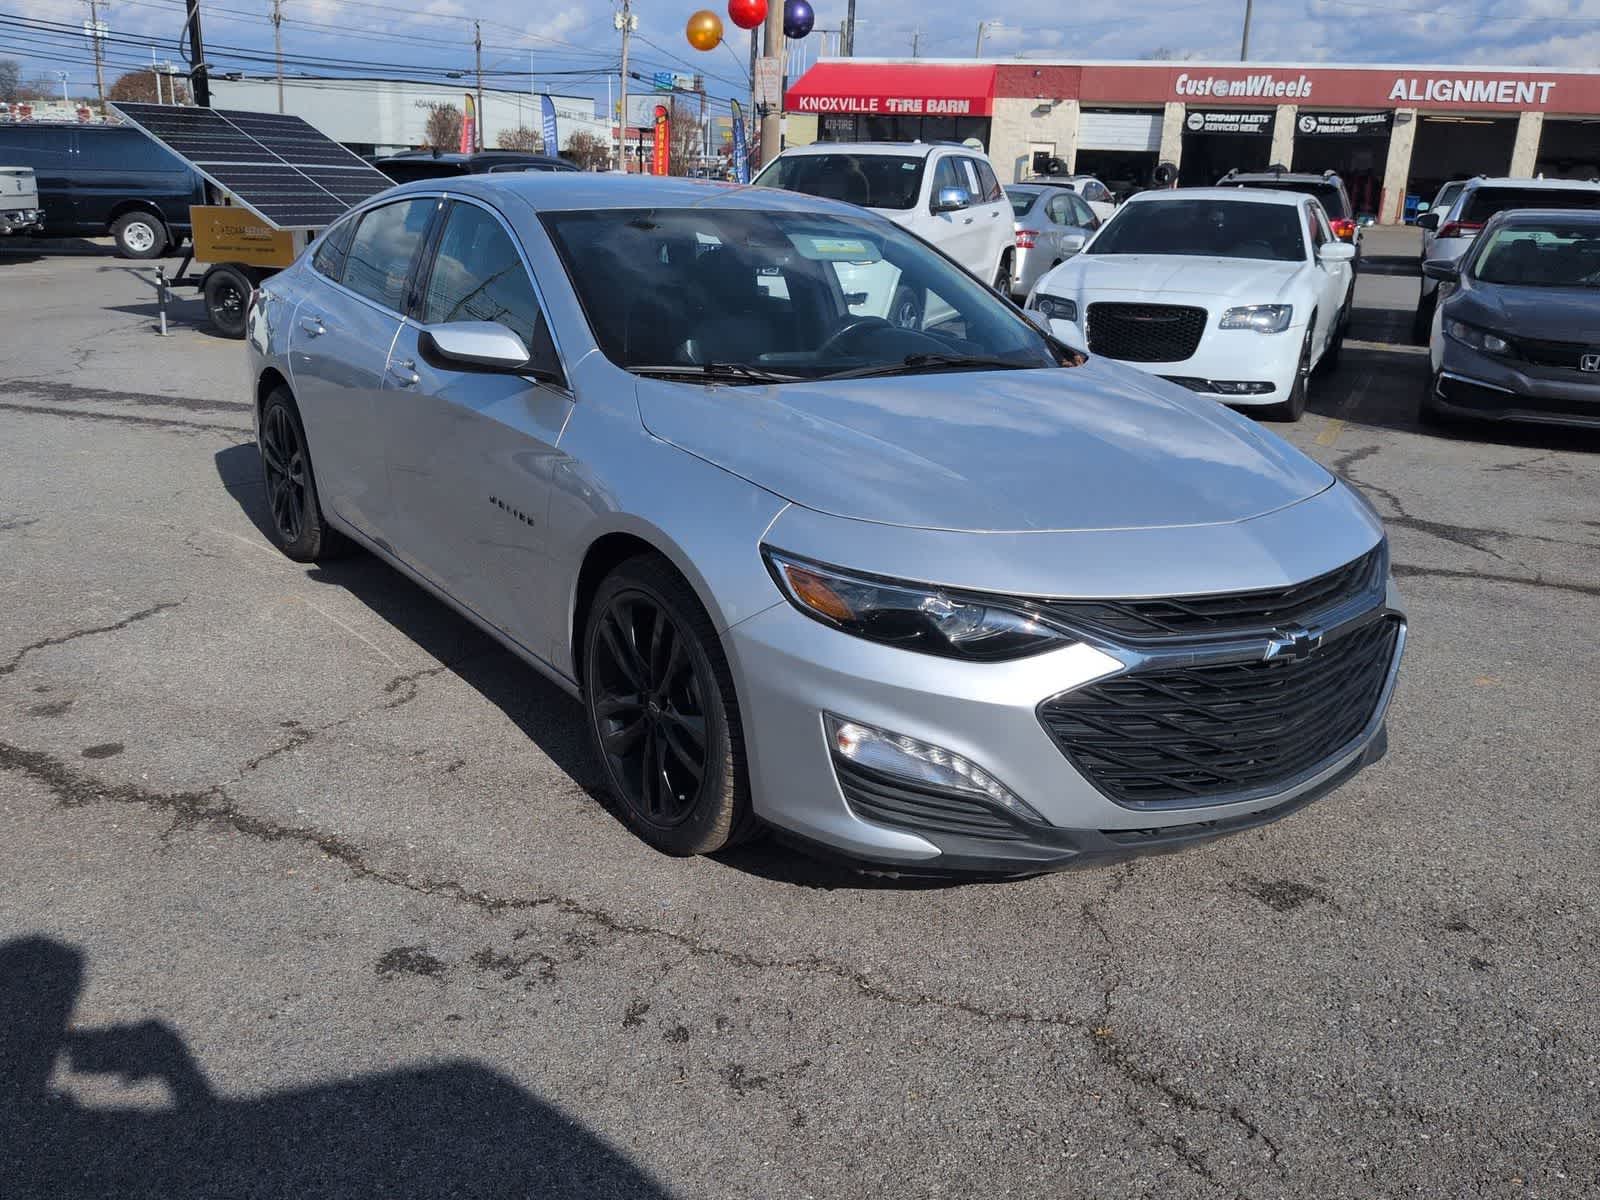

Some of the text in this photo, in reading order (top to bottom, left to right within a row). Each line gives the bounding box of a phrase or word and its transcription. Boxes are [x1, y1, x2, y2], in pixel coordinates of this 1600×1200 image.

[1388, 78, 1556, 105] ALIGNMENT
[799, 96, 879, 112] KNOXVILLE
[926, 99, 970, 114] BARN
[1204, 113, 1240, 122] COMPANY
